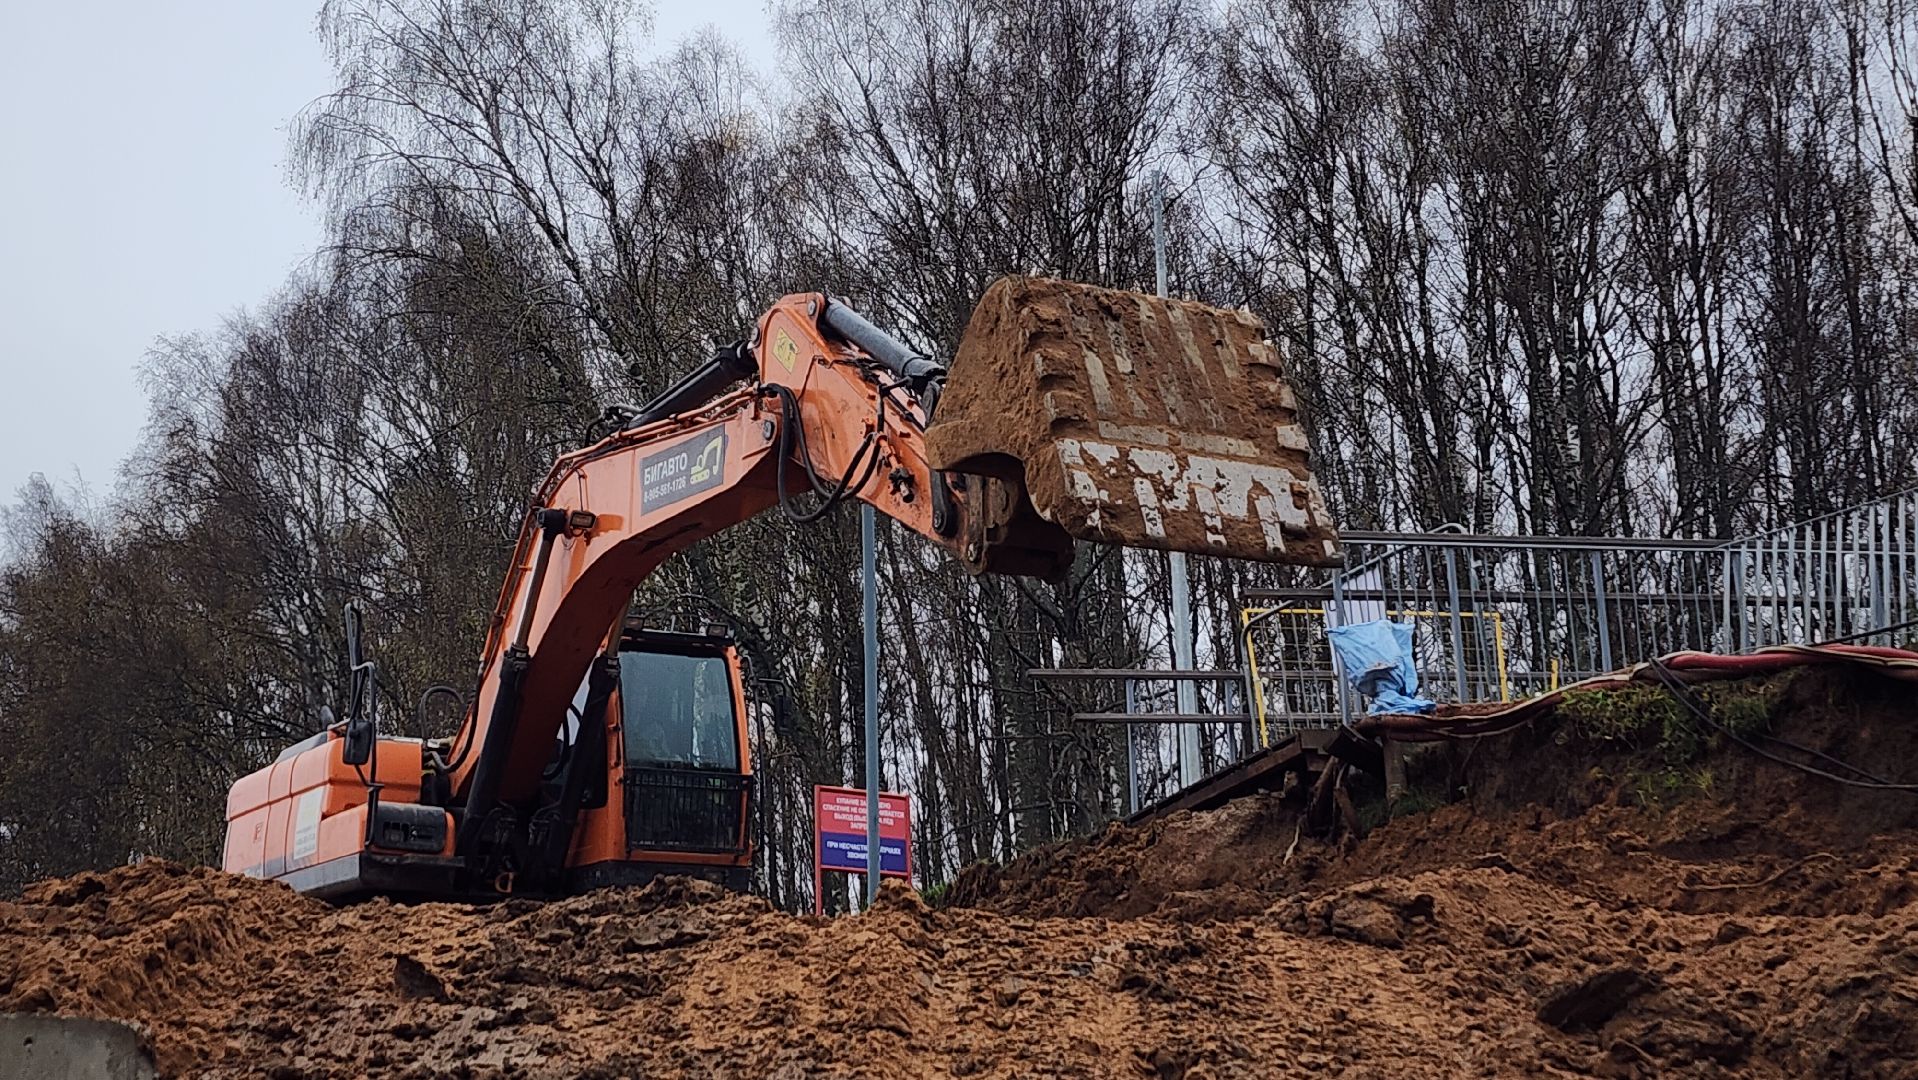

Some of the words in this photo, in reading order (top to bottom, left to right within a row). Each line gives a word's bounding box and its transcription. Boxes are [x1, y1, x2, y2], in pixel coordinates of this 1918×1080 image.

[644, 452, 688, 485] БИГАВТО
[822, 804, 850, 812] СПАСЕНИЕ
[851, 806, 858, 814] НЕ
[826, 840, 838, 849] ПРИ
